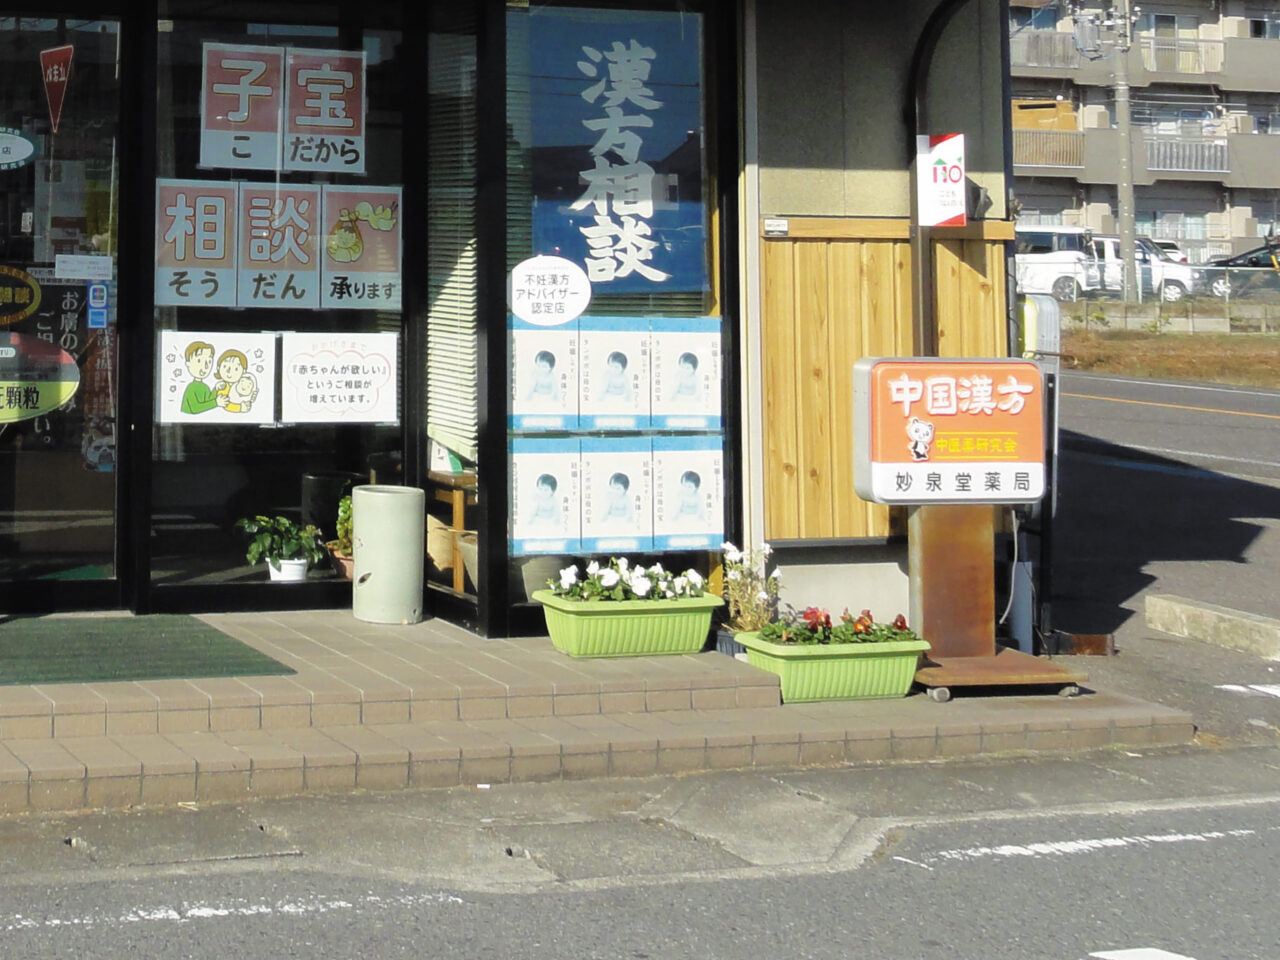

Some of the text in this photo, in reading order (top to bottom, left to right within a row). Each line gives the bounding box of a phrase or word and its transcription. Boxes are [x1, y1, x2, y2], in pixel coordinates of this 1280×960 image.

[213, 60, 354, 128] 子宝
[569, 39, 673, 283] 漢方相談
[167, 193, 309, 264] 相談
[329, 277, 397, 301] 承ります
[888, 373, 1034, 417] 中国漢方
[896, 472, 1030, 492] 妙泉堂薬局
